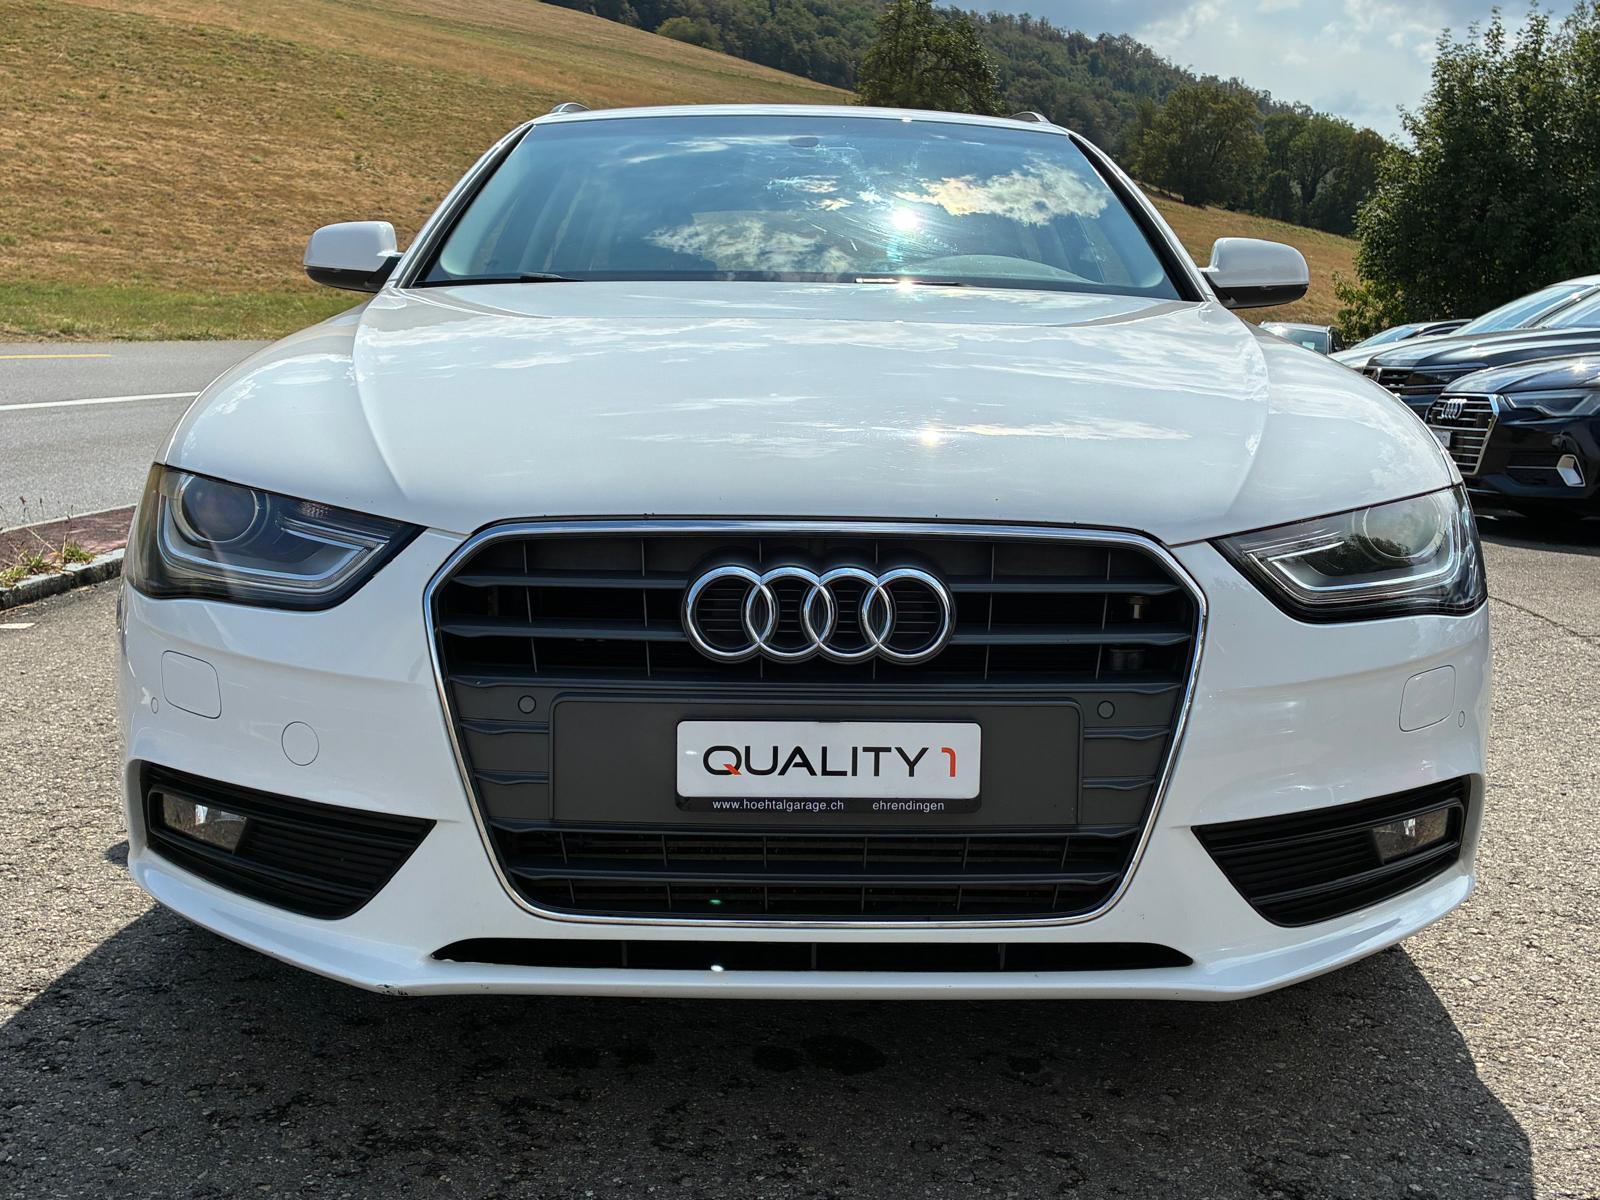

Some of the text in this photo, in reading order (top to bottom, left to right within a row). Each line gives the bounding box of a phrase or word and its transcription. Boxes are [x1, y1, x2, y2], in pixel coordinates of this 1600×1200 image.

[703, 745, 956, 777] QUALITY 1
[712, 798, 945, 812] www.hoehtalgarage.ch ehrendingen
